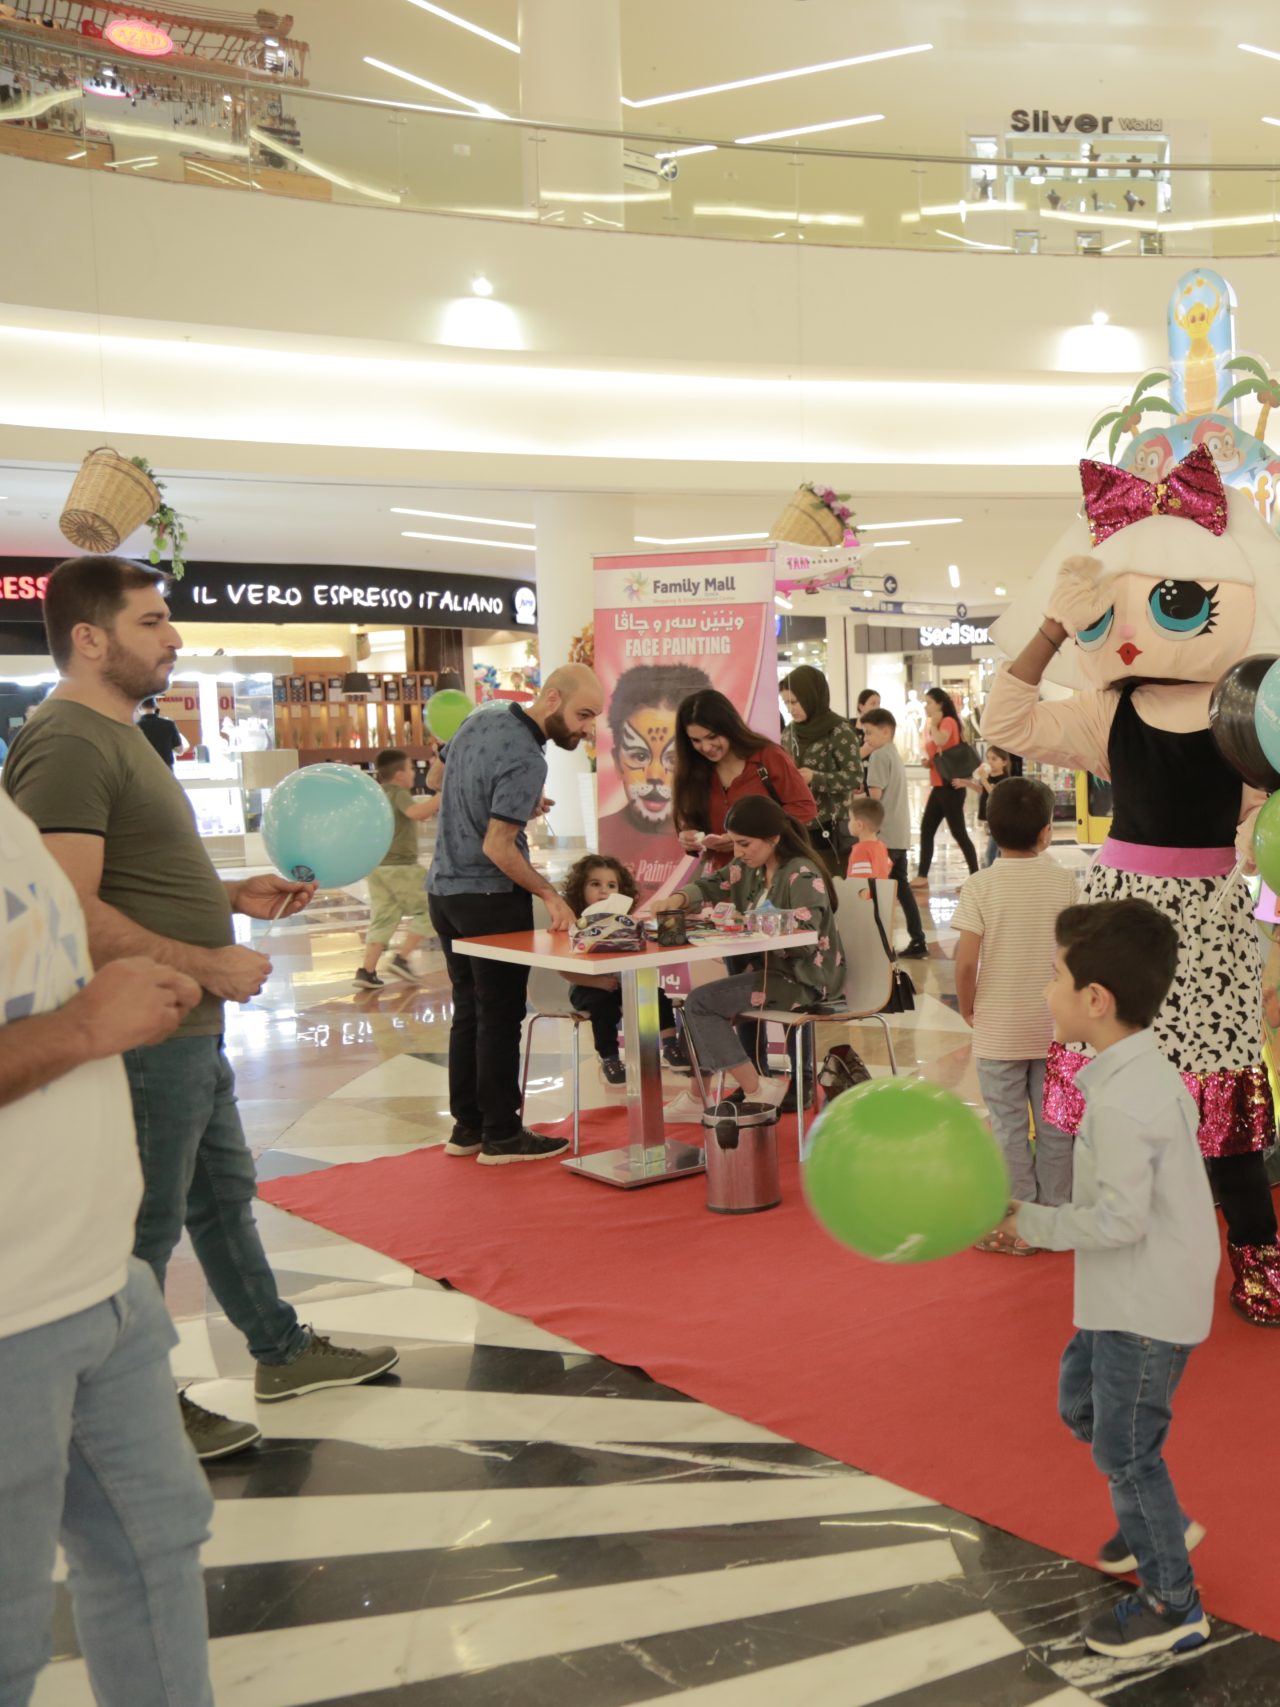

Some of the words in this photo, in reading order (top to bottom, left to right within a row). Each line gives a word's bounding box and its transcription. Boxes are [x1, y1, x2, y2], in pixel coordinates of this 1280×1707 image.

[653, 578, 700, 596] Family
[704, 576, 736, 591] Mall
[193, 586, 217, 605] IL
[227, 584, 302, 606] VERO
[313, 586, 412, 608] ESPRESSO
[419, 590, 503, 615] ITALIANO
[960, 624, 993, 645] Stor
[626, 638, 659, 657] FACE
[662, 636, 731, 656] PAINTING
